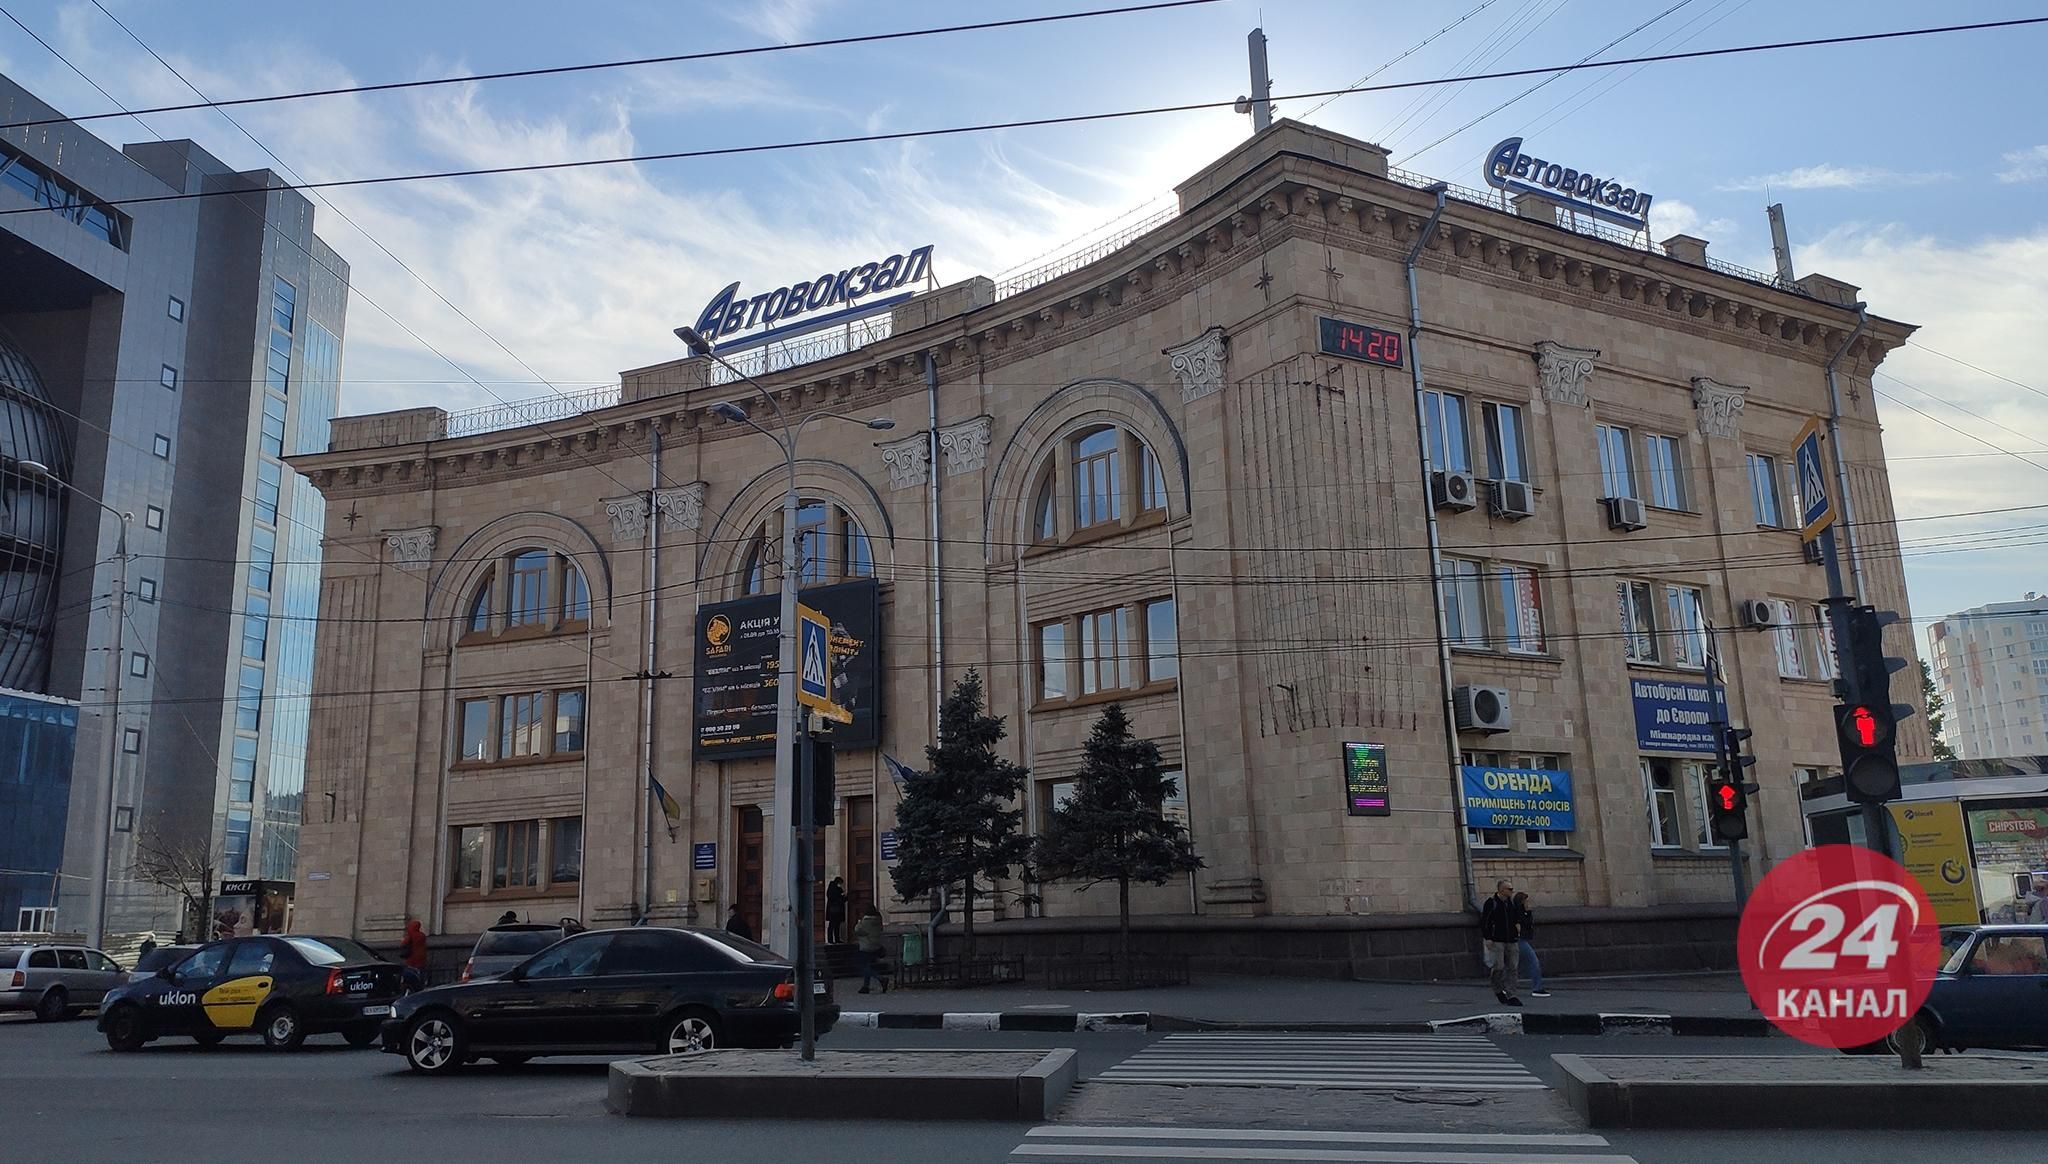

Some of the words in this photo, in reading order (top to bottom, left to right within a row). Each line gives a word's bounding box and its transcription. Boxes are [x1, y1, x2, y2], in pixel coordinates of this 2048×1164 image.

[694, 244, 934, 342] Автовокзал
[740, 618, 771, 630] АКЦІЯ
[1634, 681, 1687, 701] Автобусні
[1656, 708, 1671, 724] до
[1671, 707, 1710, 725] Європи
[1483, 771, 1553, 795] ОРЕНДА
[1468, 797, 1525, 811] ПРИМІЩЕНЬ
[1526, 799, 1538, 810] ТА
[1539, 799, 1570, 812] ОФІСІВ
[1492, 815, 1508, 826] 099
[1509, 815, 1551, 828] 722-6-000
[1988, 820, 2036, 833] CHIPSTERS
[225, 883, 252, 891] КИСЕТ
[350, 981, 374, 991] uklon
[158, 990, 196, 1006] uklon
